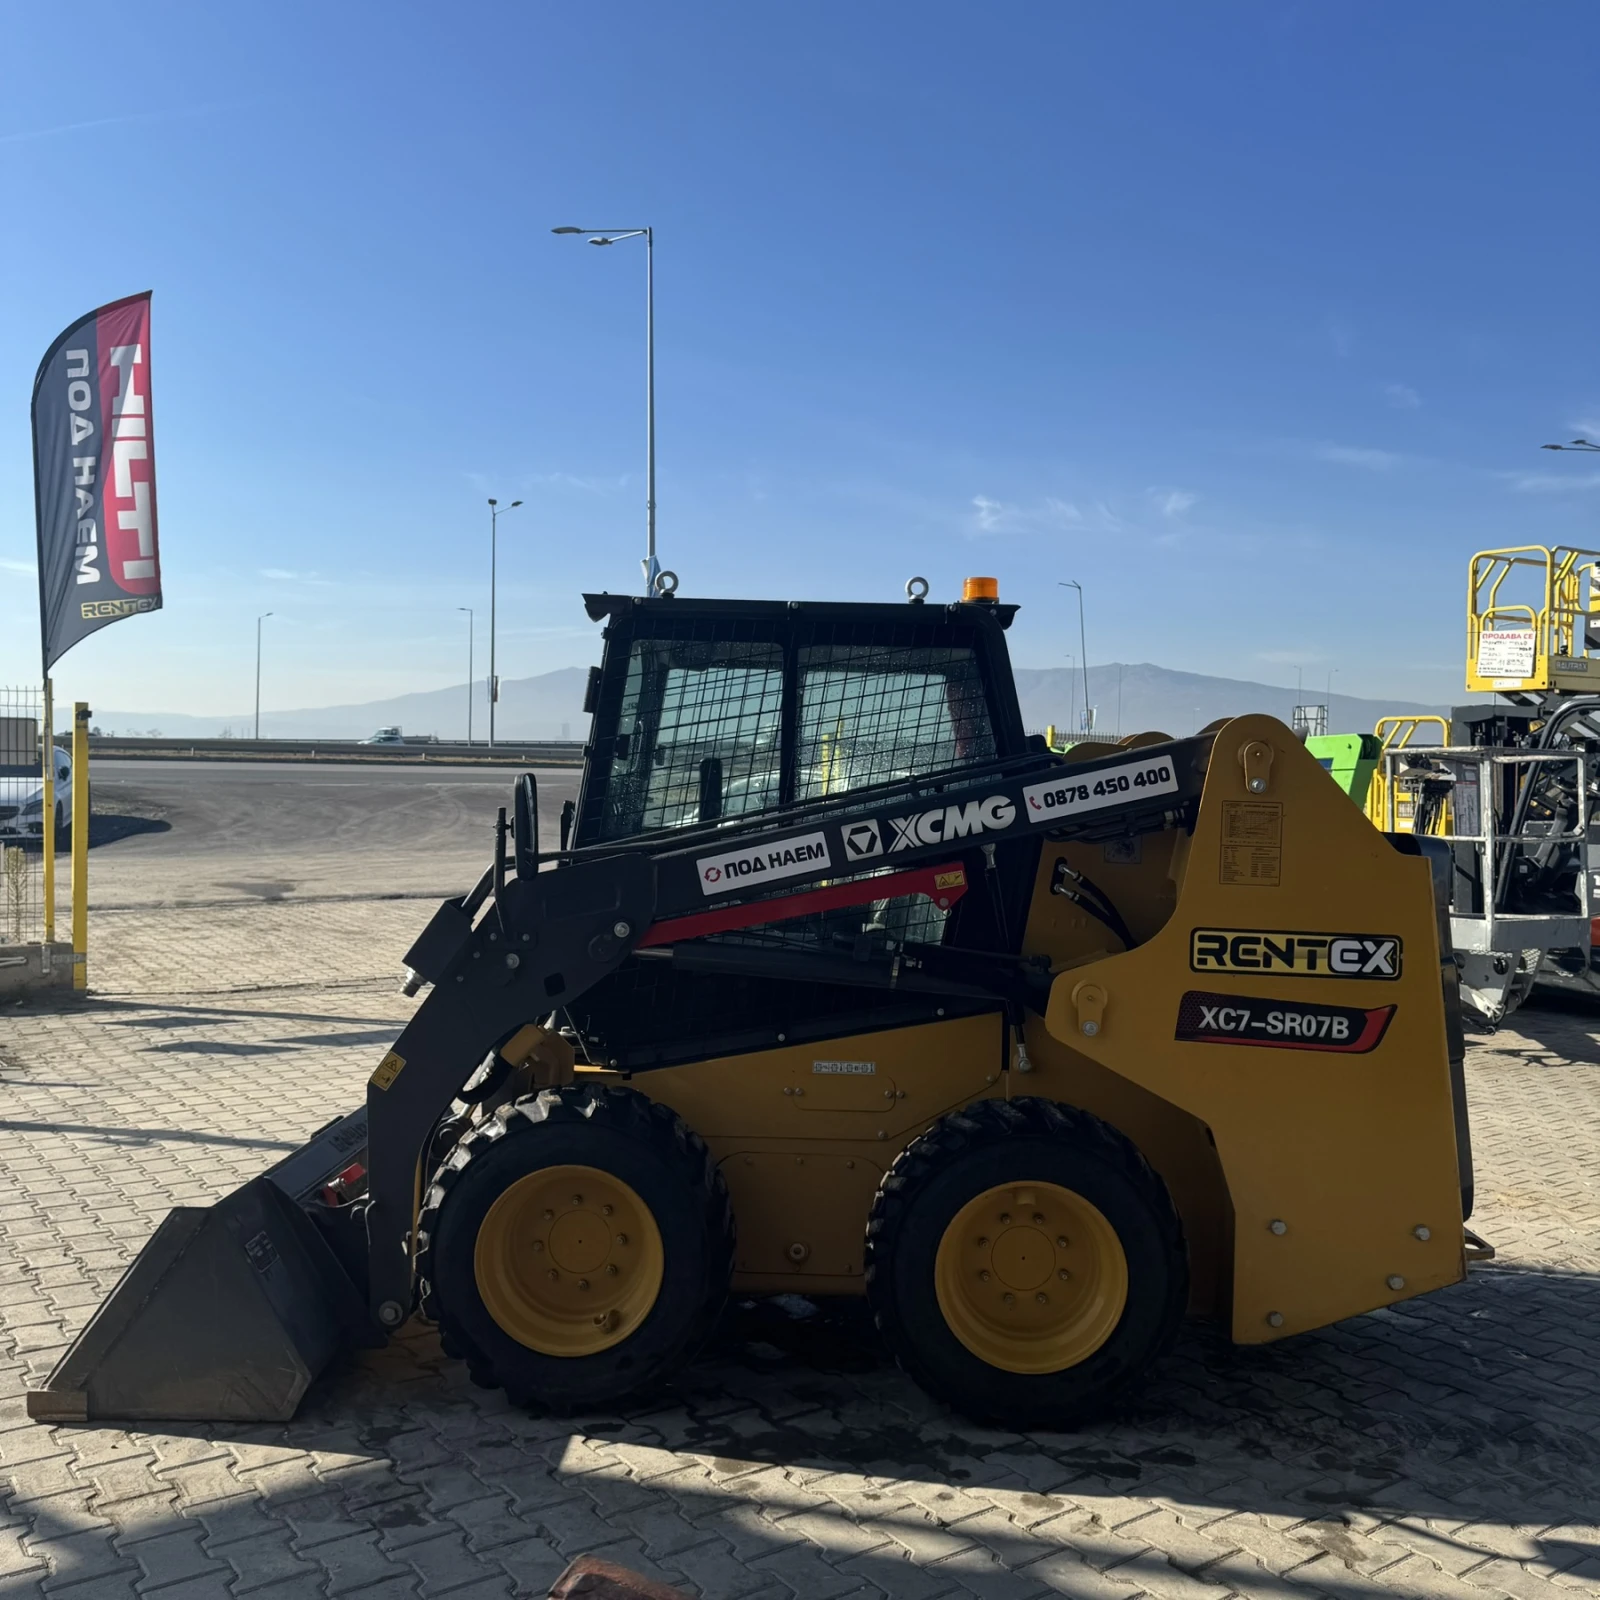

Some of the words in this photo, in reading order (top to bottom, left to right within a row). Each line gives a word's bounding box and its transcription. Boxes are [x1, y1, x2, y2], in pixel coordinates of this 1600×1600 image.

[66, 349, 93, 446] ПОД
[110, 343, 155, 580] HILTI
[72, 456, 101, 585] НАЕМ
[82, 597, 158, 618] RENTEX
[1043, 782, 1089, 808] 0878
[1093, 772, 1130, 798] 450
[1133, 765, 1171, 789] 400
[887, 795, 1016, 853] XCMG
[724, 856, 767, 881] ПОД
[767, 841, 826, 869] НАЕМ
[1197, 934, 1395, 974] RENTEX
[1198, 1005, 1350, 1039] XC7-SR07B
